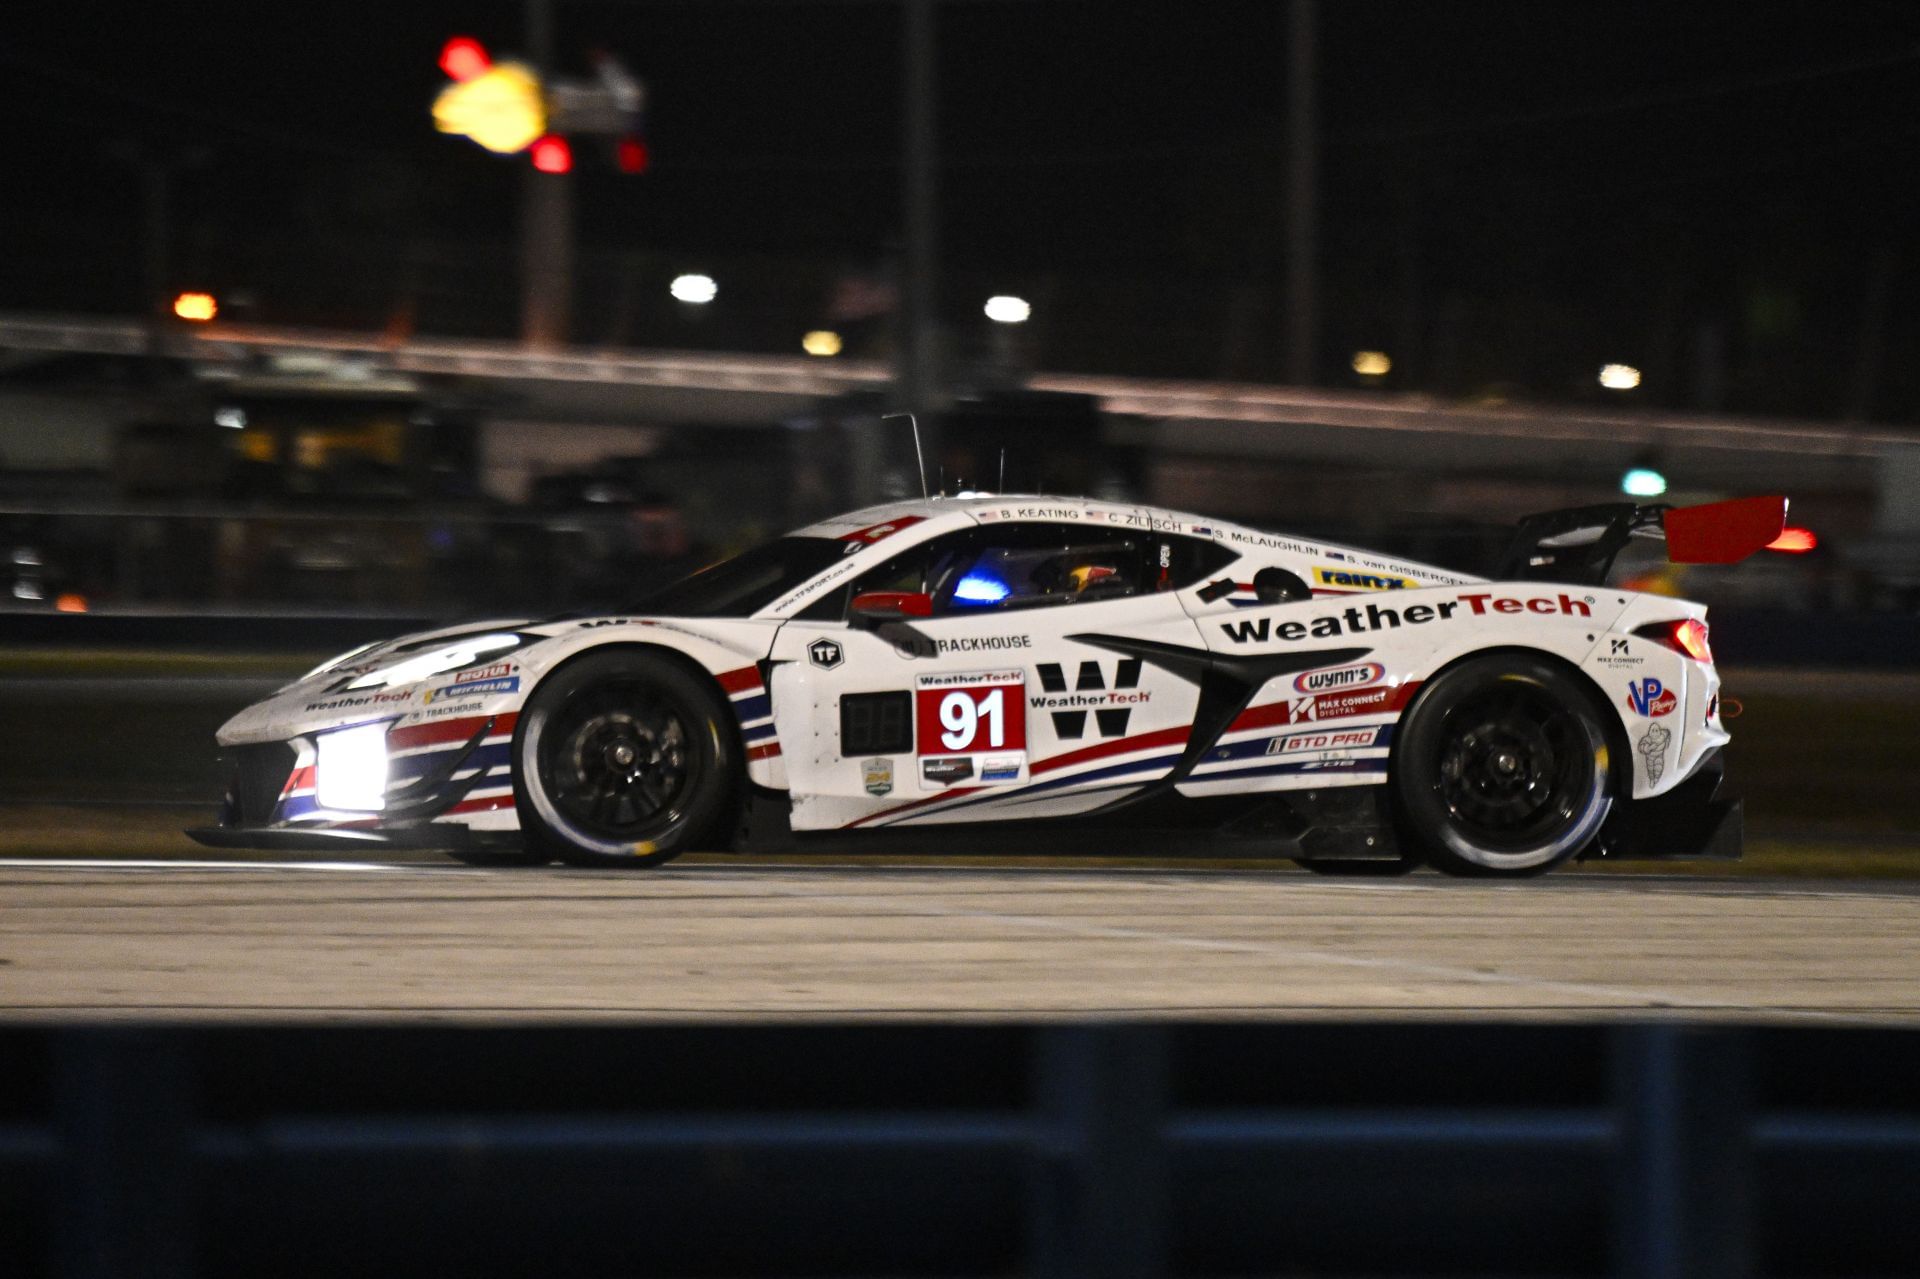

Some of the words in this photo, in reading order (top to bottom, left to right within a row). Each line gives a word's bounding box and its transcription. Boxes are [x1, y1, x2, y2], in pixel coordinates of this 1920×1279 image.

[1000, 510, 1012, 520] B.
[1017, 508, 1079, 520] KEATING
[1108, 513, 1120, 523] C.
[1126, 514, 1182, 532] ZILISCH
[1214, 529, 1226, 539] S.
[1231, 532, 1318, 556] McLAUGHLIN
[1346, 555, 1359, 565] S.
[1363, 560, 1386, 570] van
[813, 646, 837, 661] TF
[459, 665, 508, 682] MOTUL
[920, 672, 1023, 686] WeatherTech
[305, 690, 412, 712] WeatherTech
[1030, 691, 1150, 708] WeatherTech
[1318, 700, 1340, 710] MAX
[1341, 692, 1386, 706] CONNECT
[1628, 677, 1663, 718] VP
[426, 702, 483, 717] TRACKHOUSE
[1319, 707, 1356, 718] DIGITAL
[939, 688, 1004, 751] 91
[1287, 736, 1327, 750] GTD
[1331, 732, 1373, 746] PRO
